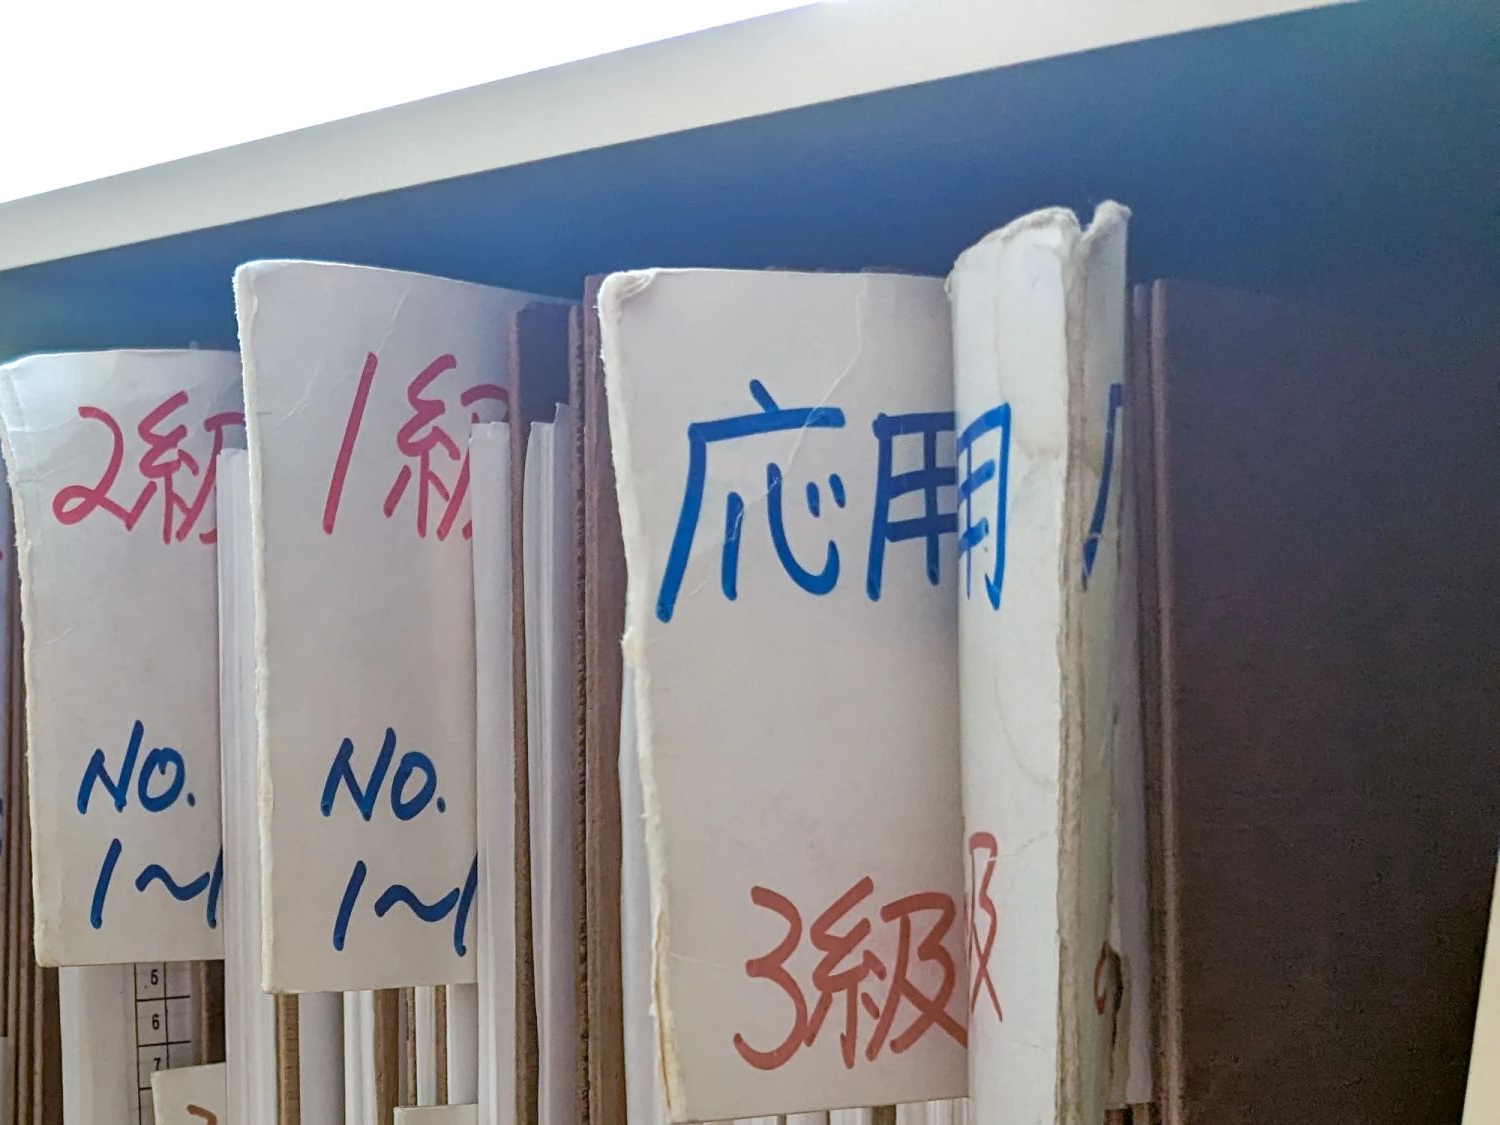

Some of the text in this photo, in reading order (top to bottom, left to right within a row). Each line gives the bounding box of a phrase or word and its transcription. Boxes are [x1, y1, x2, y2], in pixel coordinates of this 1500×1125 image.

[656, 379, 1011, 623] 応用
[151, 1014, 161, 1030] 6
[734, 832, 1003, 1071] 3級
